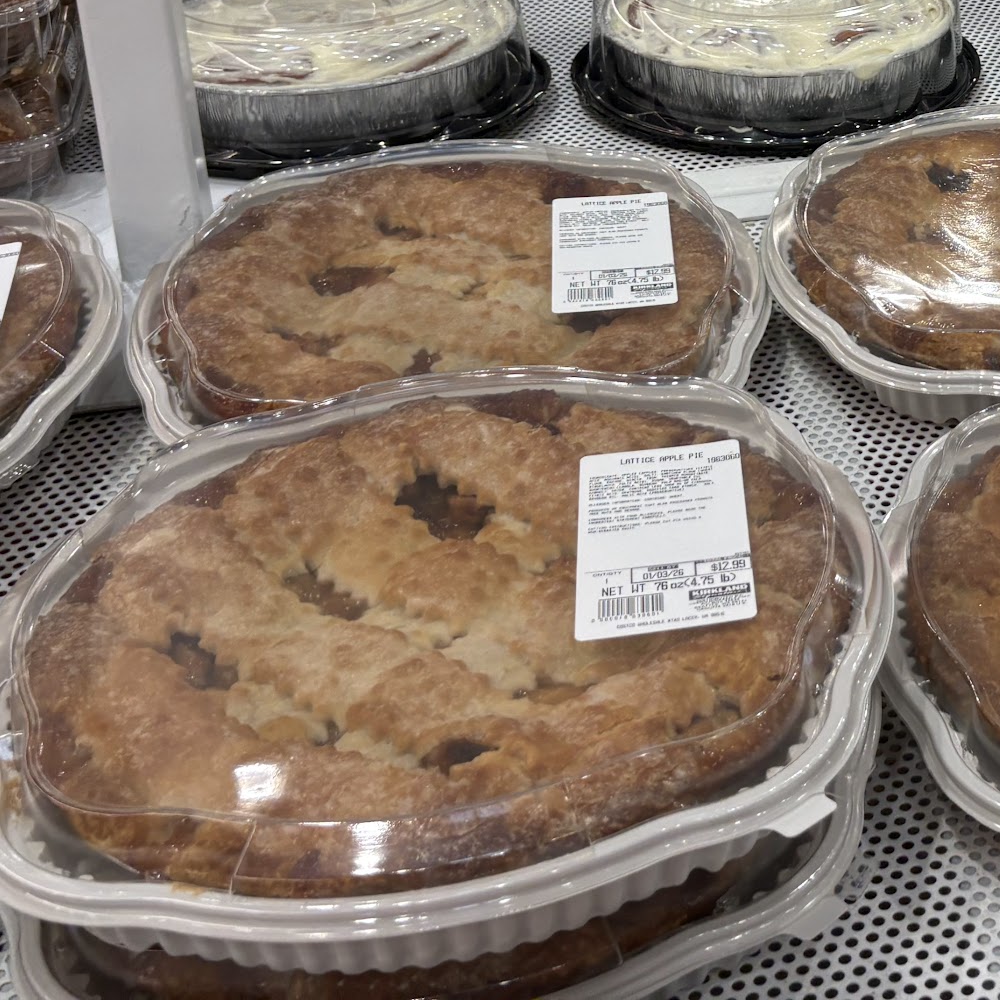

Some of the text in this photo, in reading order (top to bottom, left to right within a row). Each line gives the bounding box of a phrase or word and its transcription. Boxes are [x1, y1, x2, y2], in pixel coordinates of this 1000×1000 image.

[620, 451, 704, 466] LATTICE APPLE PIE
[711, 559, 746, 572] $12.99
[642, 569, 684, 580] 01/03/26
[601, 585, 623, 597] NET
[631, 583, 646, 593] WT
[654, 581, 668, 591] 76
[691, 583, 748, 597] KIRKLAND
